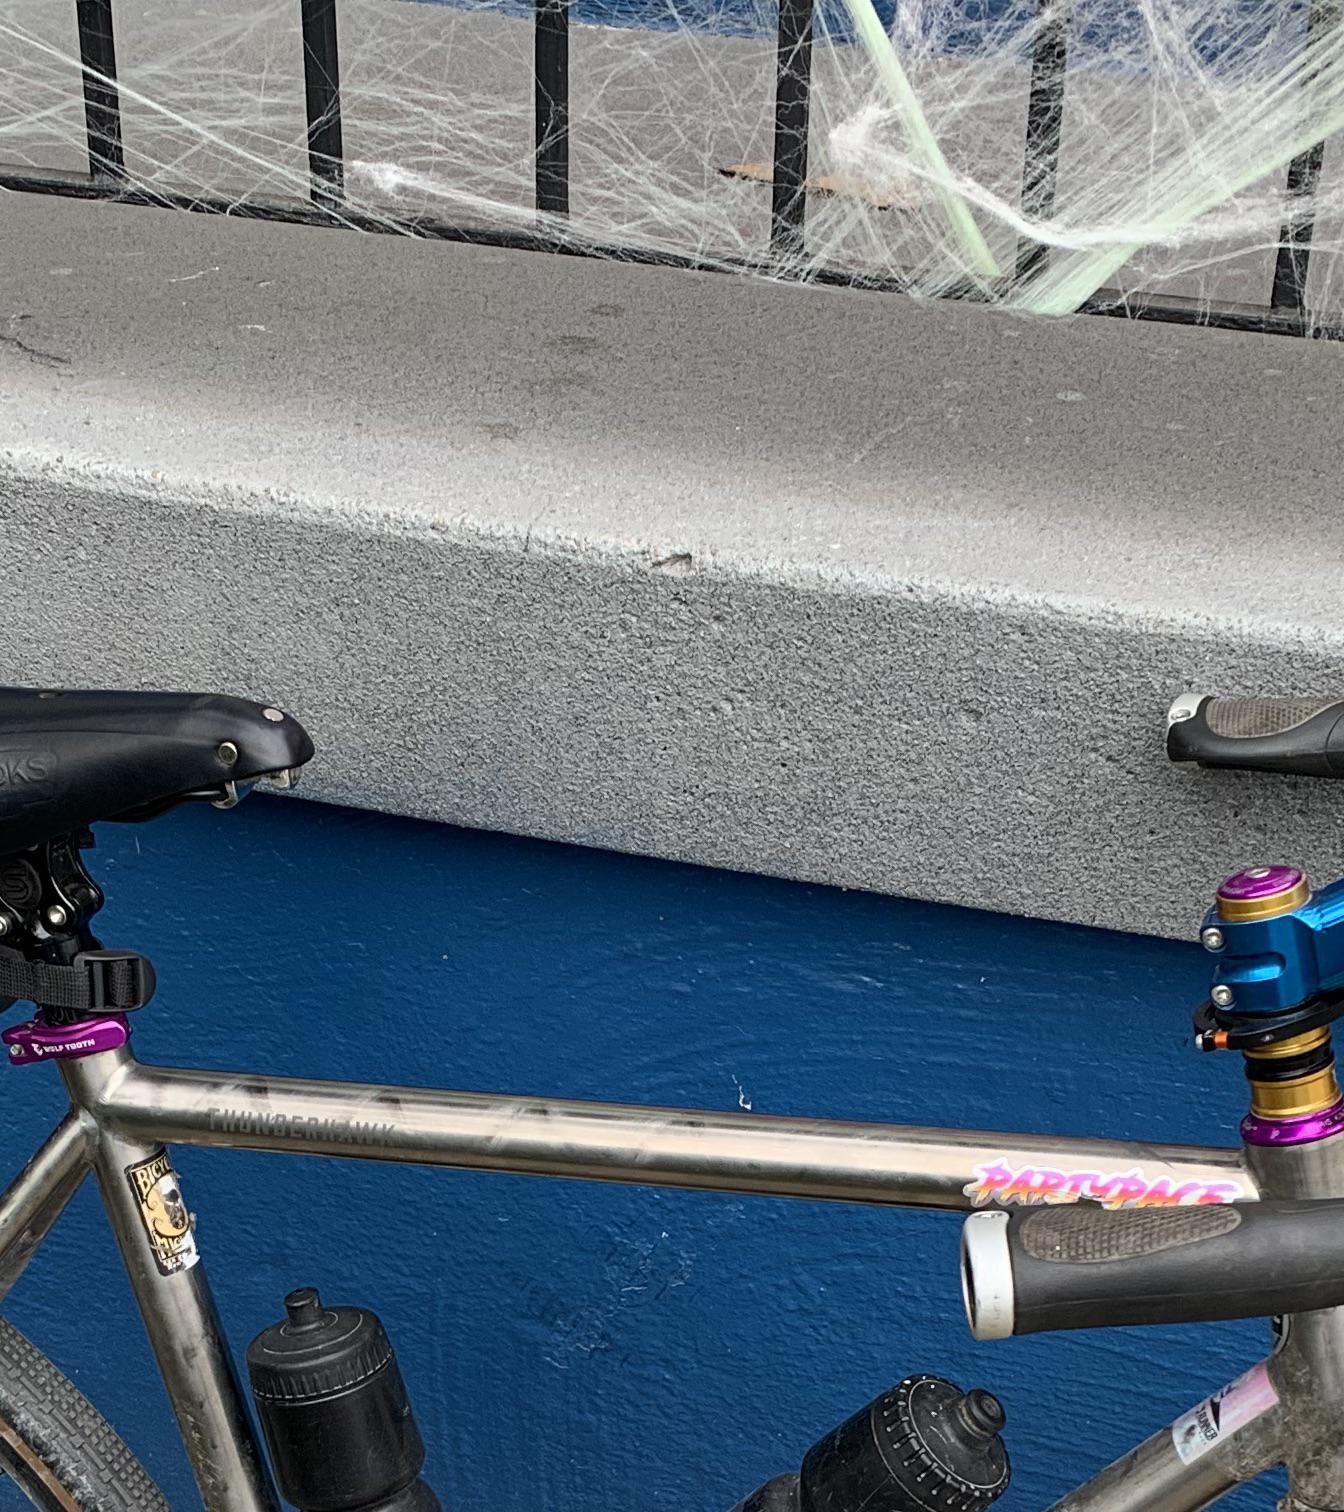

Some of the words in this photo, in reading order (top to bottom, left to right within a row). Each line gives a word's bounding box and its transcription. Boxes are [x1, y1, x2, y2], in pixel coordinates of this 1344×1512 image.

[64, 1038, 97, 1051] TOOTH
[206, 1106, 397, 1147] THUNDERHAWK
[135, 1155, 172, 1201] BICYC
